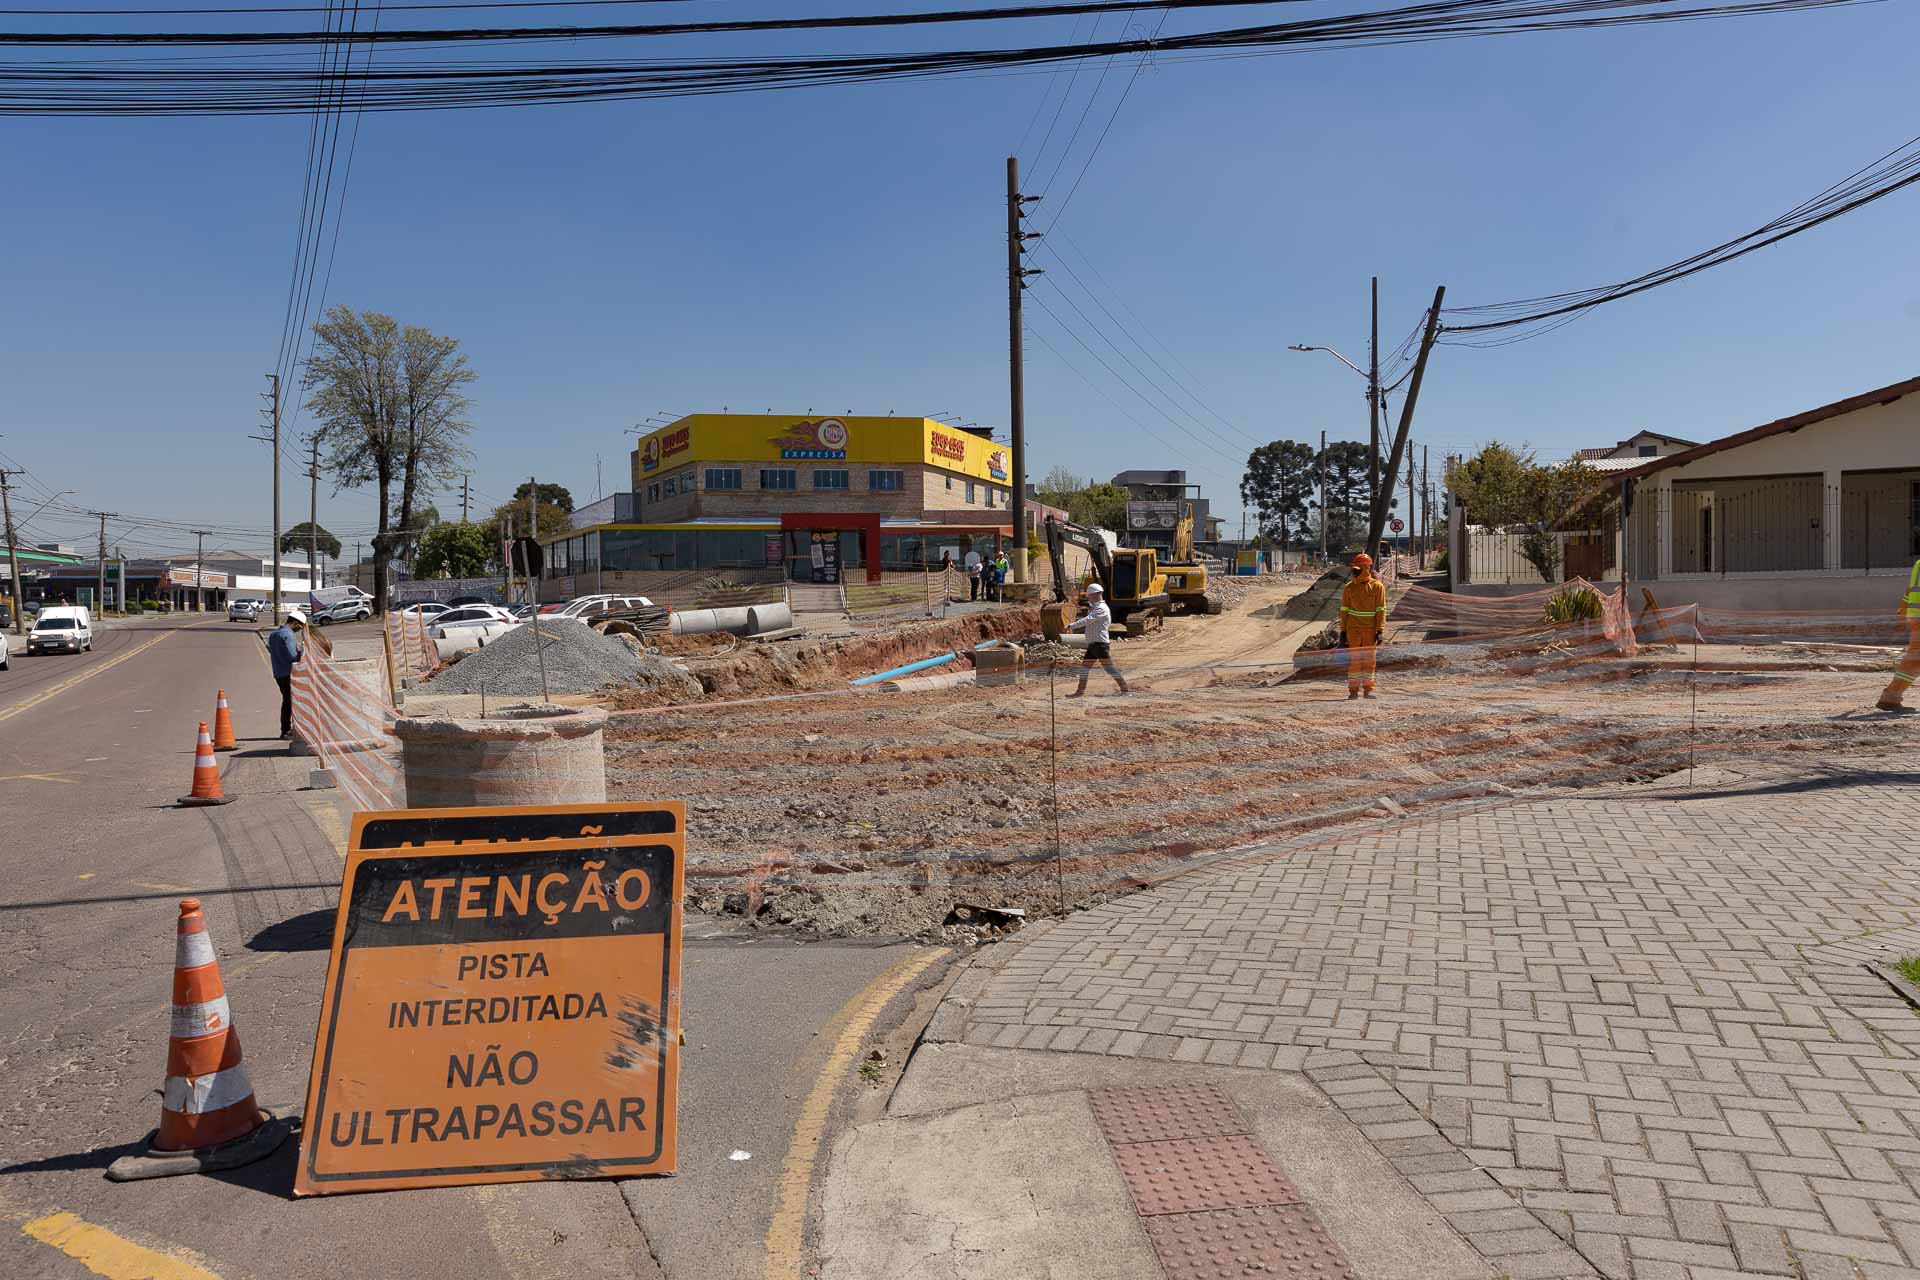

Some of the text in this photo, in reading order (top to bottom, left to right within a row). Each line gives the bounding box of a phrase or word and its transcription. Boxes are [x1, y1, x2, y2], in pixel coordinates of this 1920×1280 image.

[381, 863, 651, 926] ATENÇÃO
[458, 952, 550, 981] PISTA
[388, 992, 608, 1028] INTERDITADA
[446, 1045, 539, 1089] NÃO
[330, 1097, 647, 1147] ULTRAPASSAR
